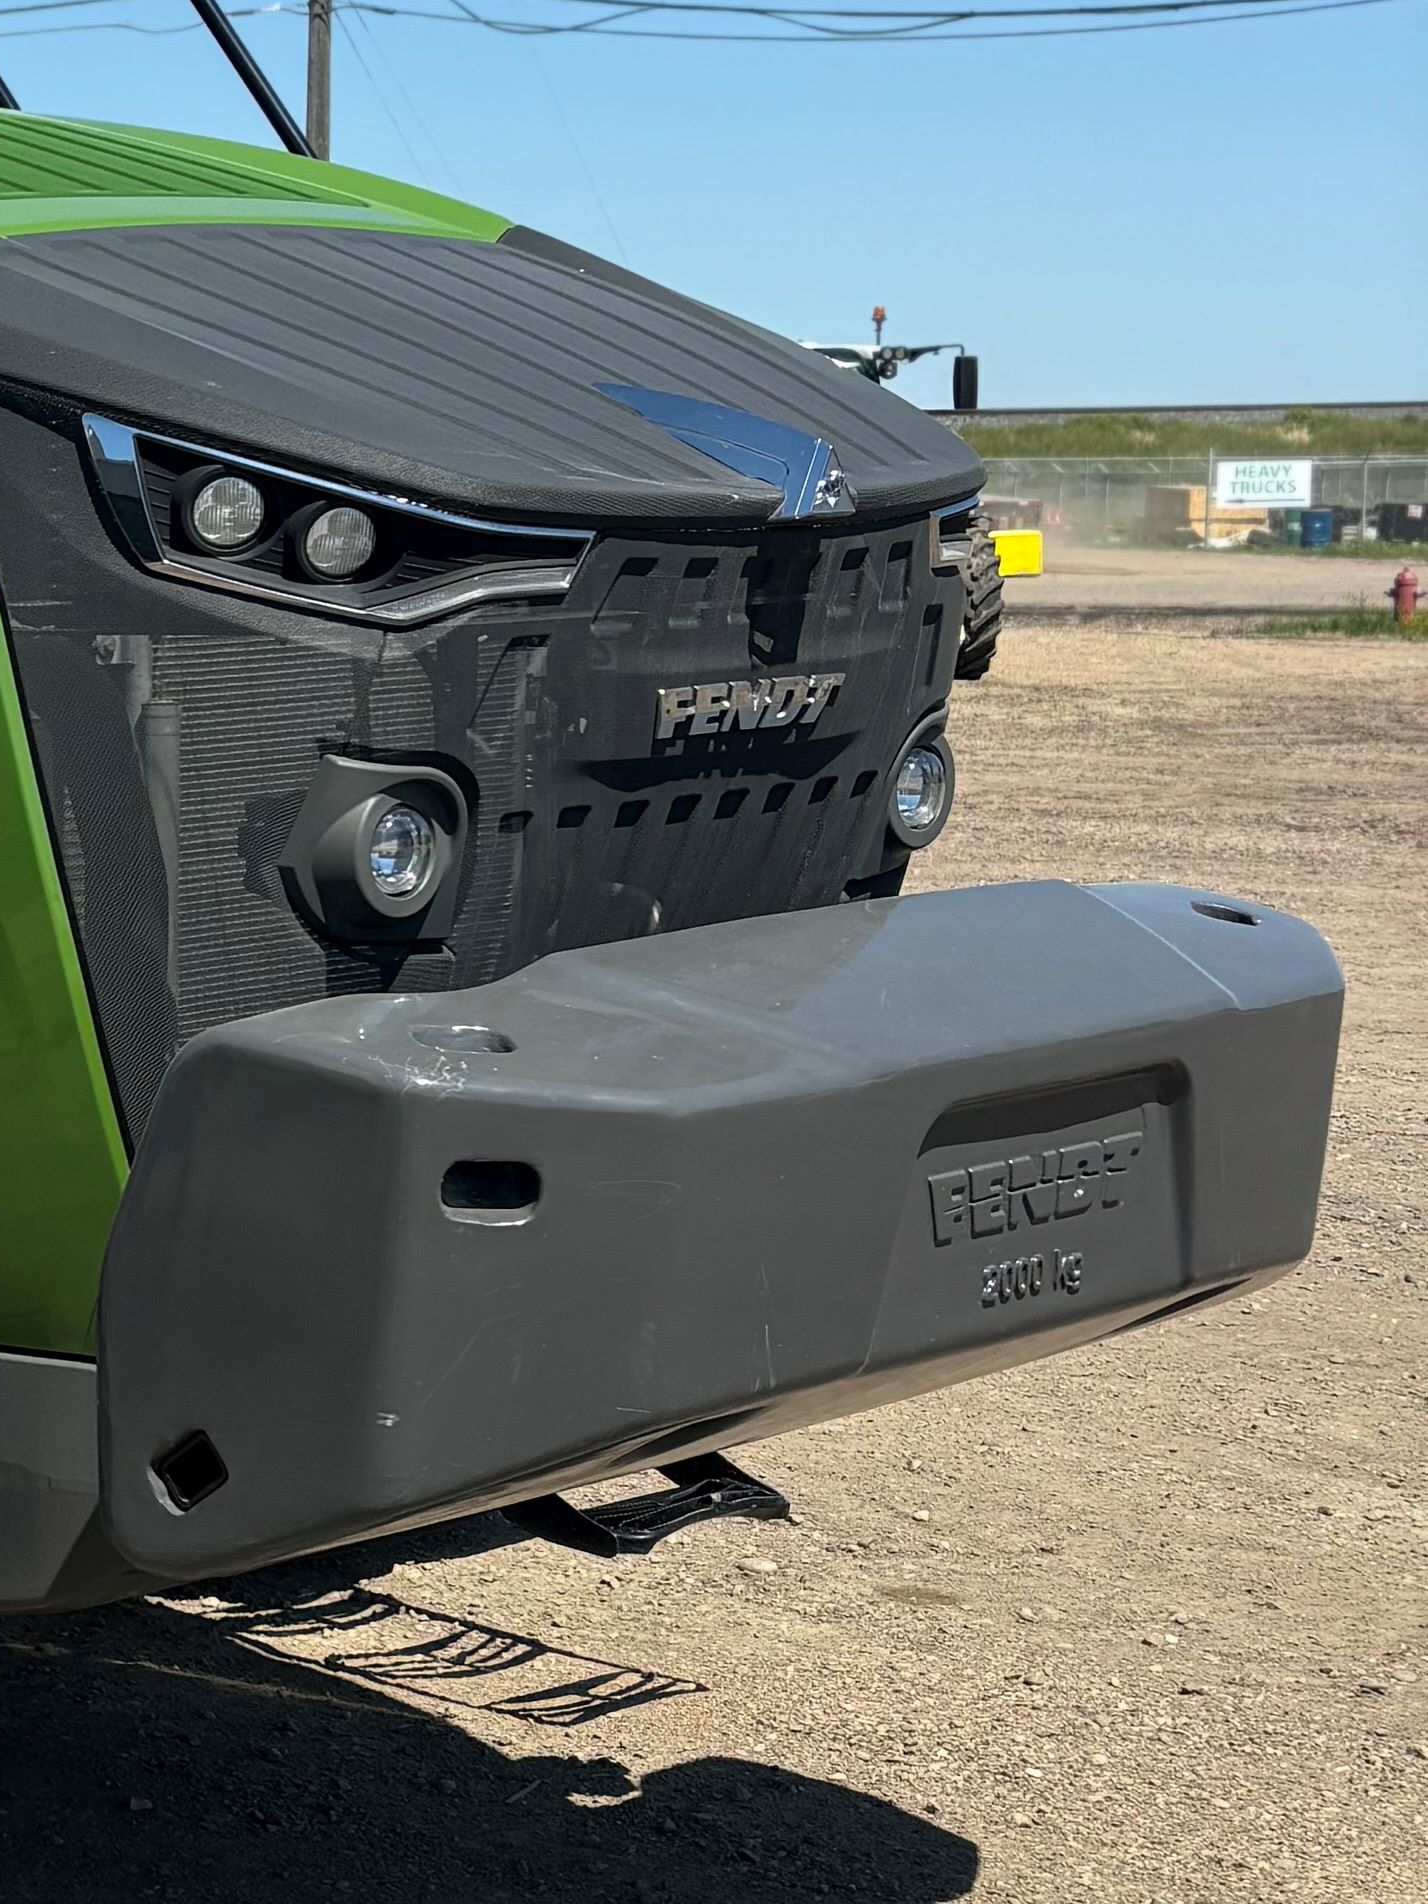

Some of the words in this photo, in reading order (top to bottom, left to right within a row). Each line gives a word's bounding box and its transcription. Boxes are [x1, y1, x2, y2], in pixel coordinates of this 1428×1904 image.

[1229, 479, 1297, 495] TRUCKS
[1234, 464, 1293, 479] HEAVY
[655, 673, 846, 740] FENDT
[928, 1132, 1143, 1248] FENDT
[980, 1253, 1044, 1309] 2000
[1052, 1248, 1083, 1295] kg
